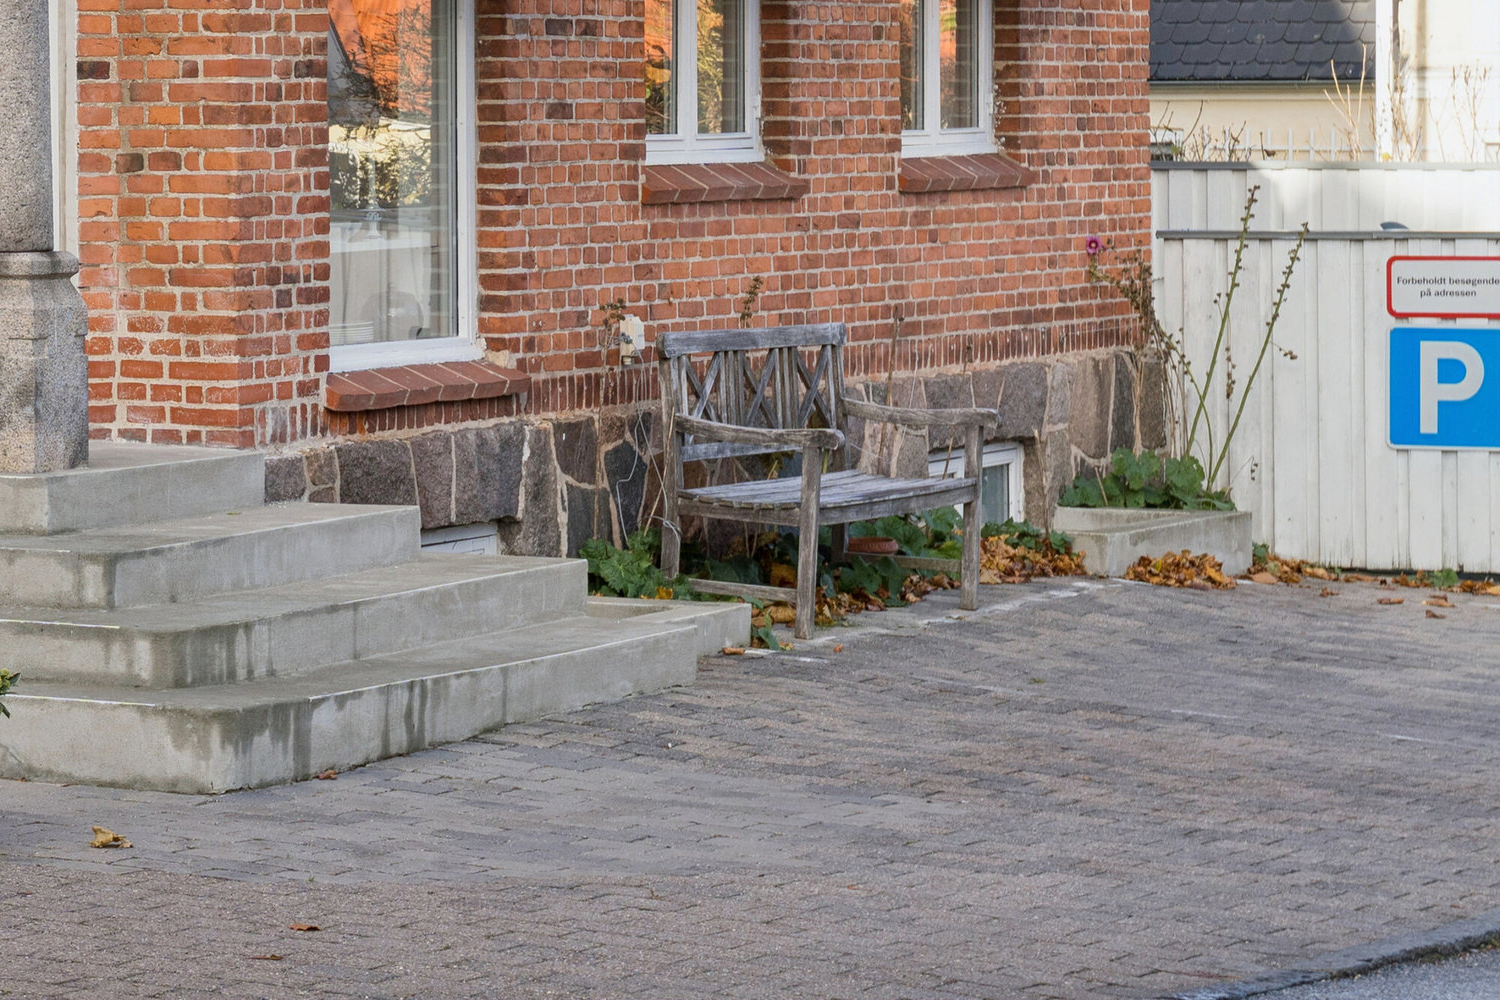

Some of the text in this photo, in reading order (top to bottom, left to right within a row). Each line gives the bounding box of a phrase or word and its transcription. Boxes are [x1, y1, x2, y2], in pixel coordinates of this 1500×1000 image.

[1396, 276, 1500, 287] Forbeholdt besøgende
[1419, 288, 1477, 298] på adressen
[1420, 340, 1485, 435] P
